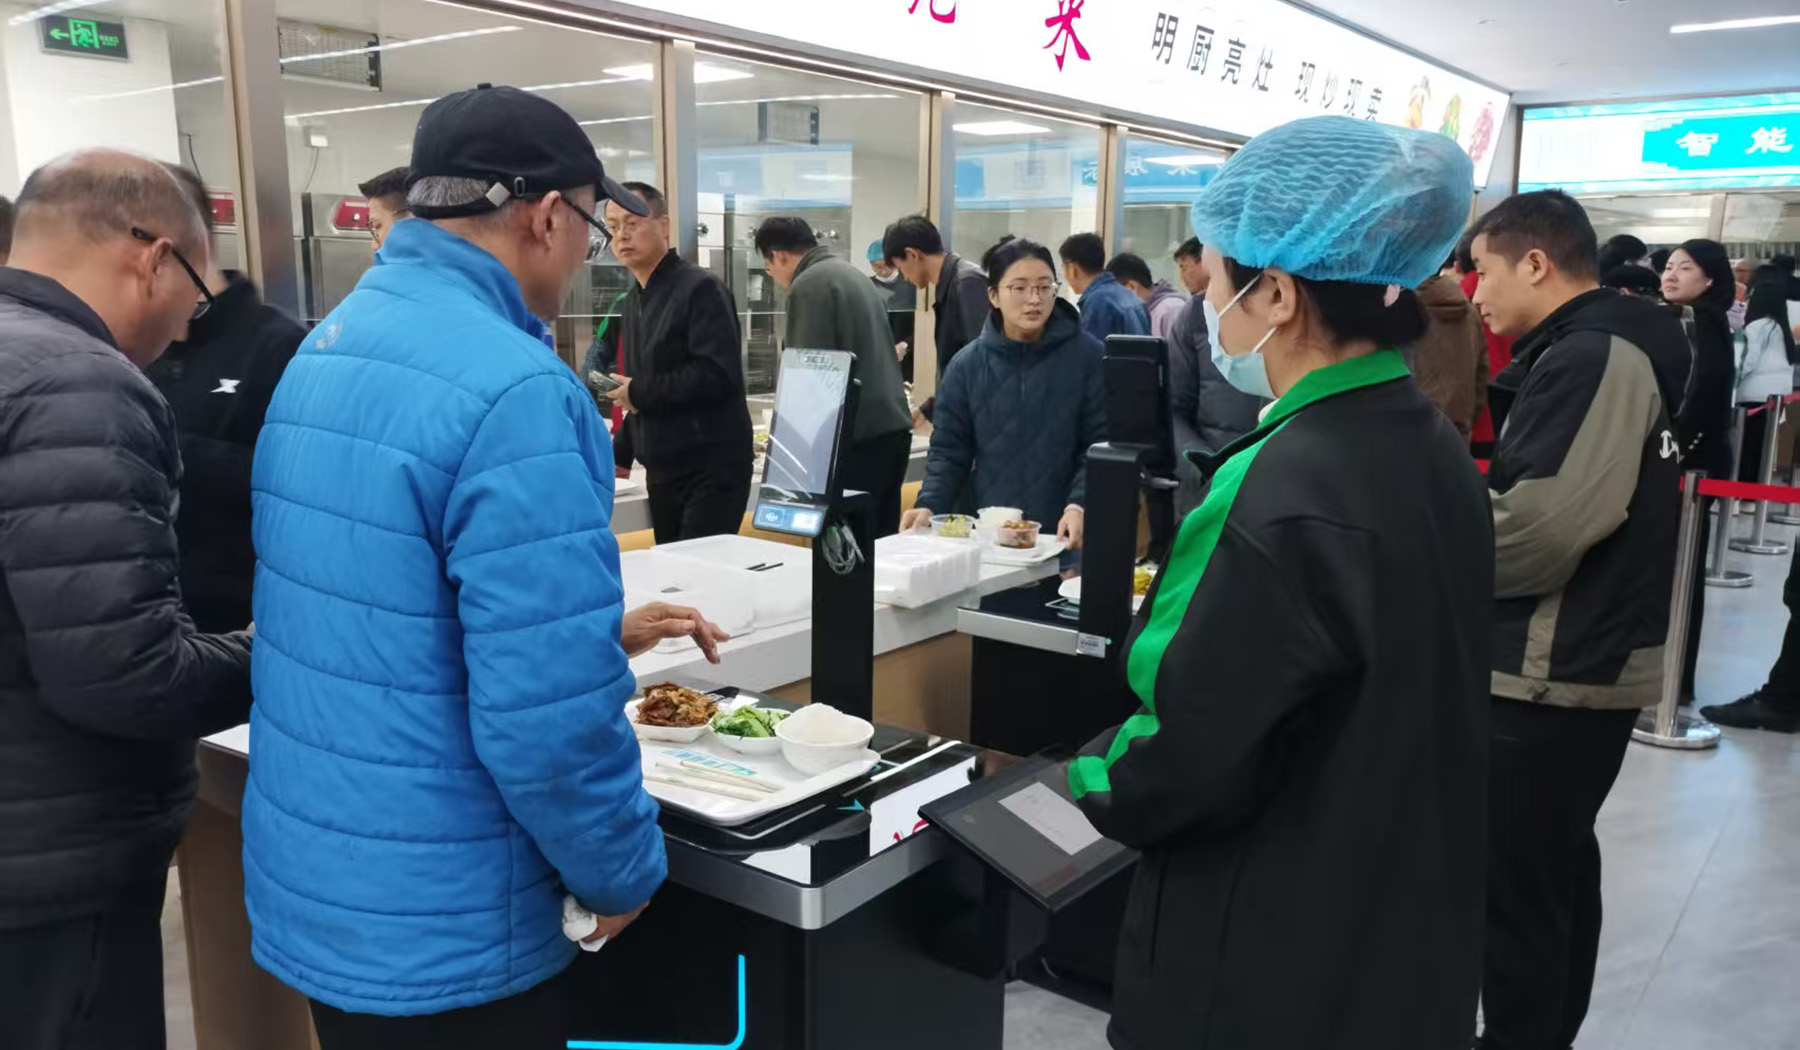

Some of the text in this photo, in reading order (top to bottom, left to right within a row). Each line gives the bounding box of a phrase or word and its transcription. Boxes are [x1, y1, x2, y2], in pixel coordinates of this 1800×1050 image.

[1151, 12, 1383, 122] 明厨亮灶 现炒现卖
[1675, 125, 1795, 157] 智能
